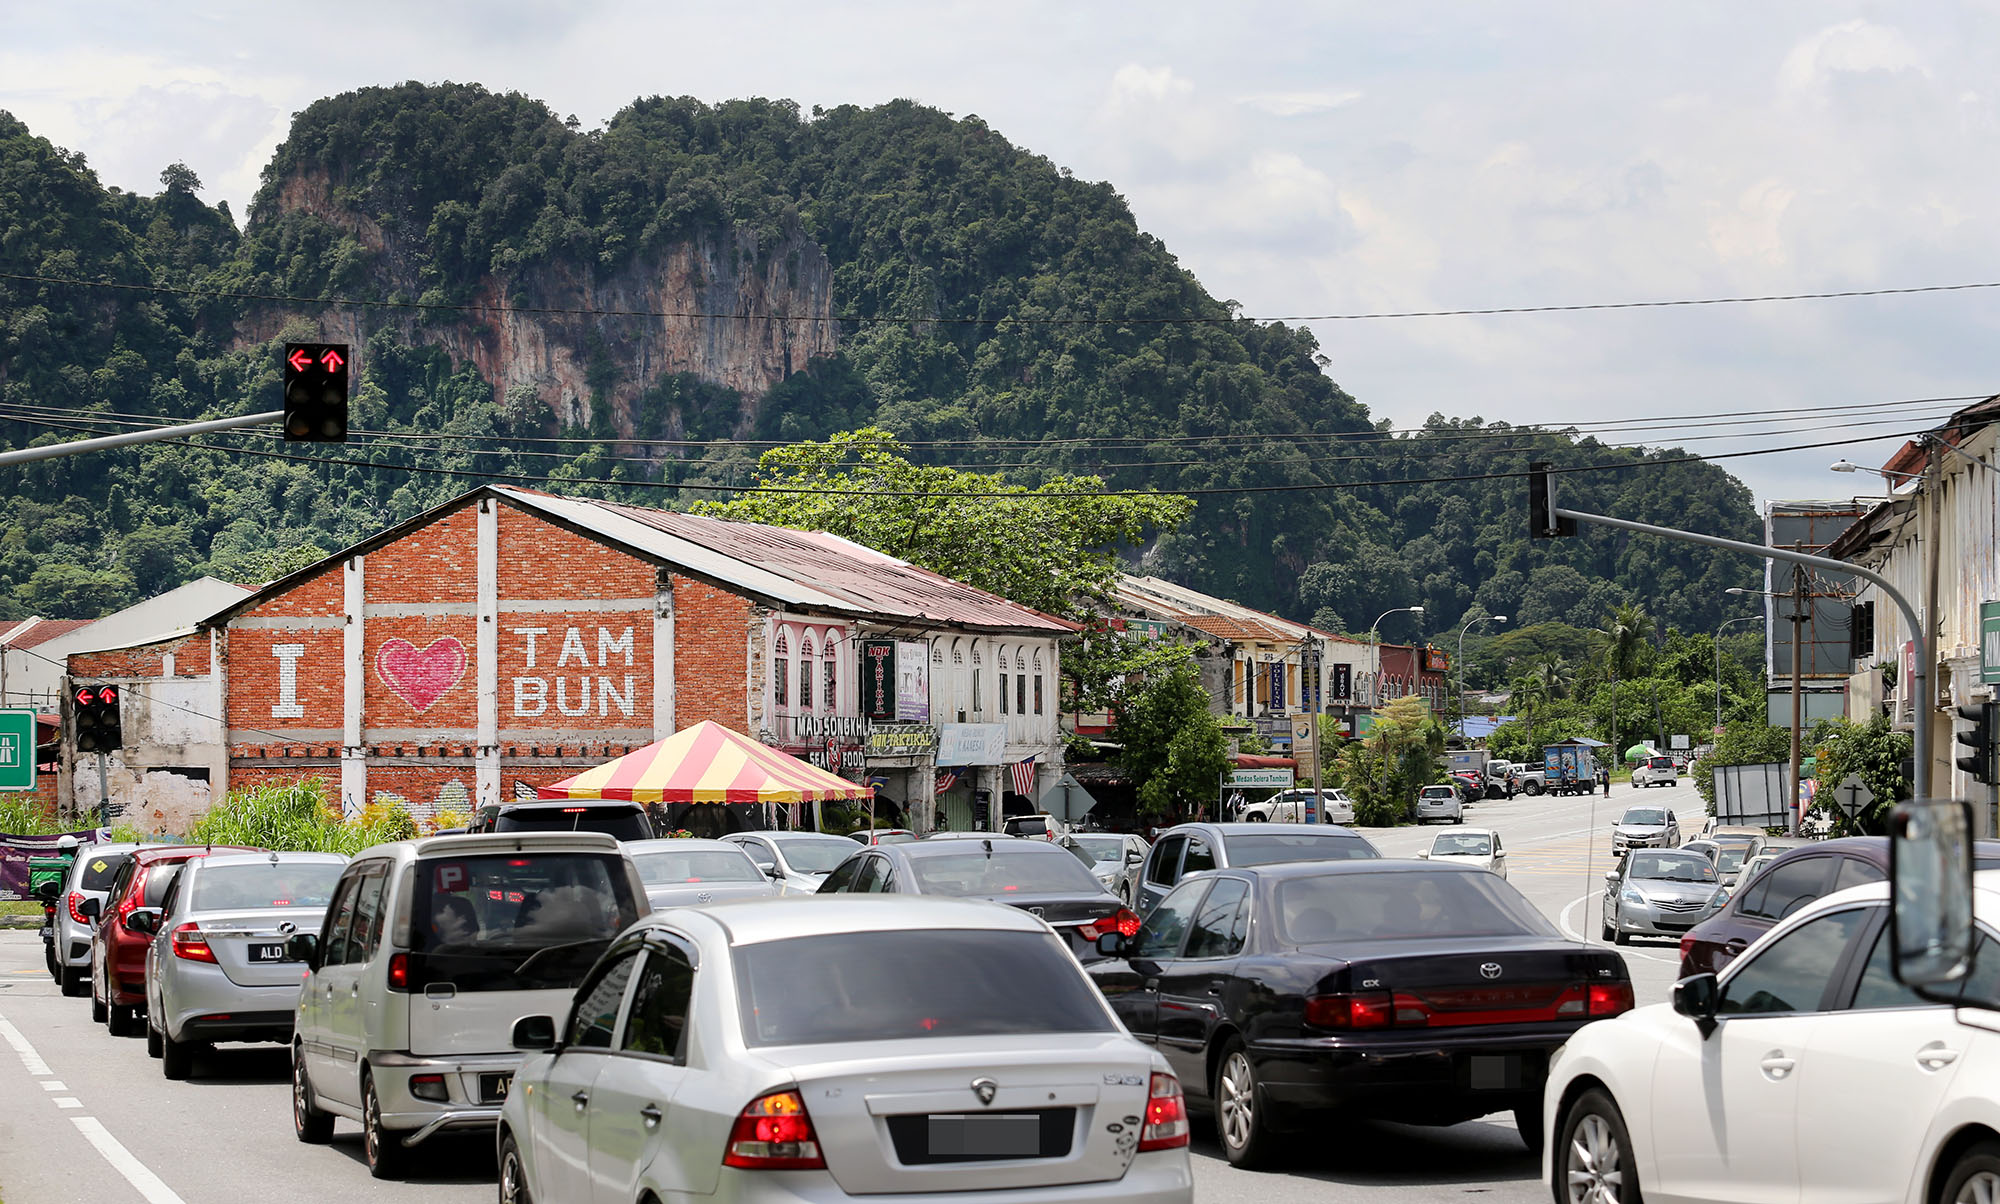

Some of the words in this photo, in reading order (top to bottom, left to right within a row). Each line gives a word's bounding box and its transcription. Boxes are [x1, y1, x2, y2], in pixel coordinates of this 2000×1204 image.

[513, 627, 635, 668] TAM
[271, 643, 304, 719] I
[875, 656, 884, 711] TAKTIKAL
[1273, 664, 1281, 708] POLIKLINIK
[512, 675, 636, 718] BUN
[796, 717, 820, 737] MAD
[823, 717, 873, 737] SONGKHLA
[889, 733, 932, 746] TAKTIKAL
[809, 751, 826, 768] SEA
[843, 751, 864, 767] FOOD
[1236, 774, 1253, 783] Medan
[1254, 774, 1269, 783] Selera
[1270, 774, 1289, 783] Tambun
[440, 867, 463, 889] P
[260, 946, 283, 959] ALD
[1362, 979, 1380, 988] GX
